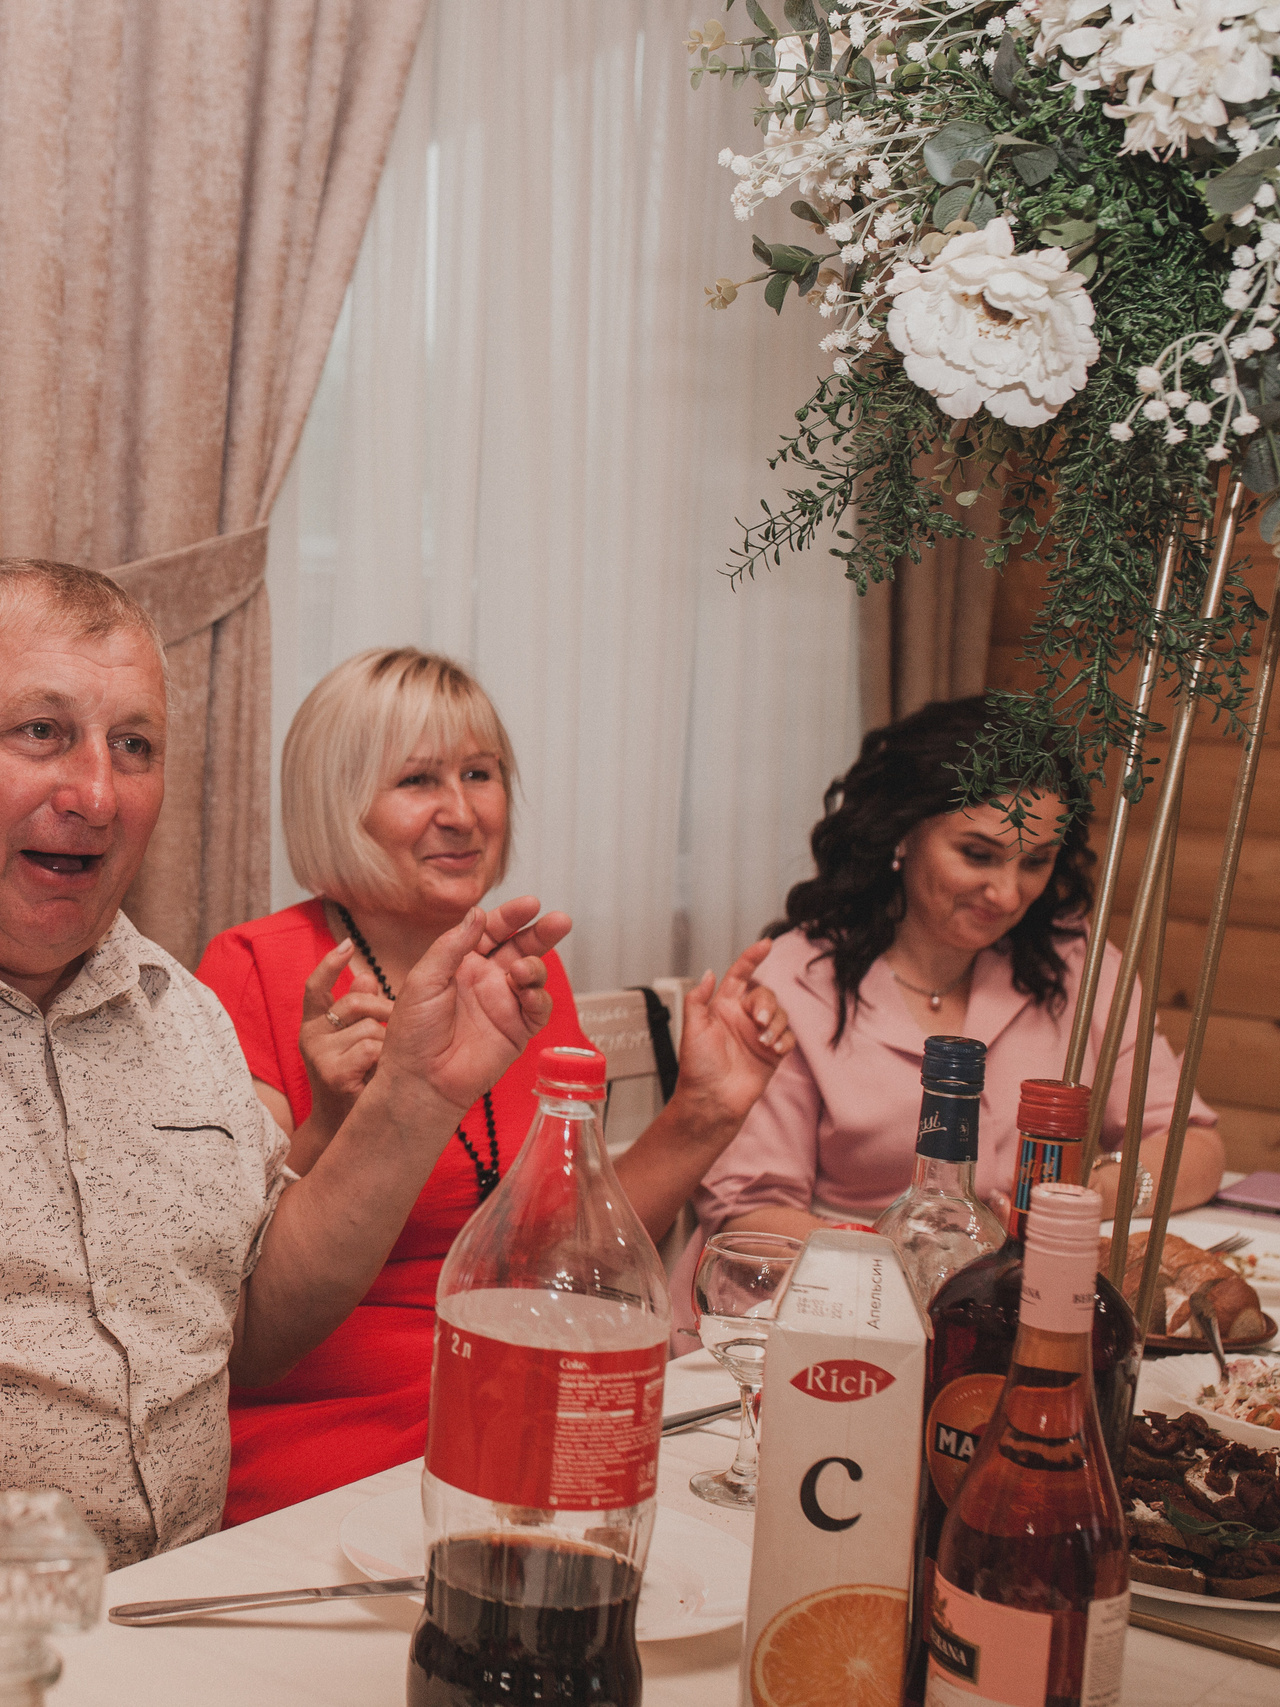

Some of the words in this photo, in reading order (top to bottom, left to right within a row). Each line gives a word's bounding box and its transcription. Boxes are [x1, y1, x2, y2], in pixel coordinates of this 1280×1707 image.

[866, 1258, 883, 1330] Апельсин
[451, 1332, 460, 1355] 2
[806, 1365, 877, 1396] Rich
